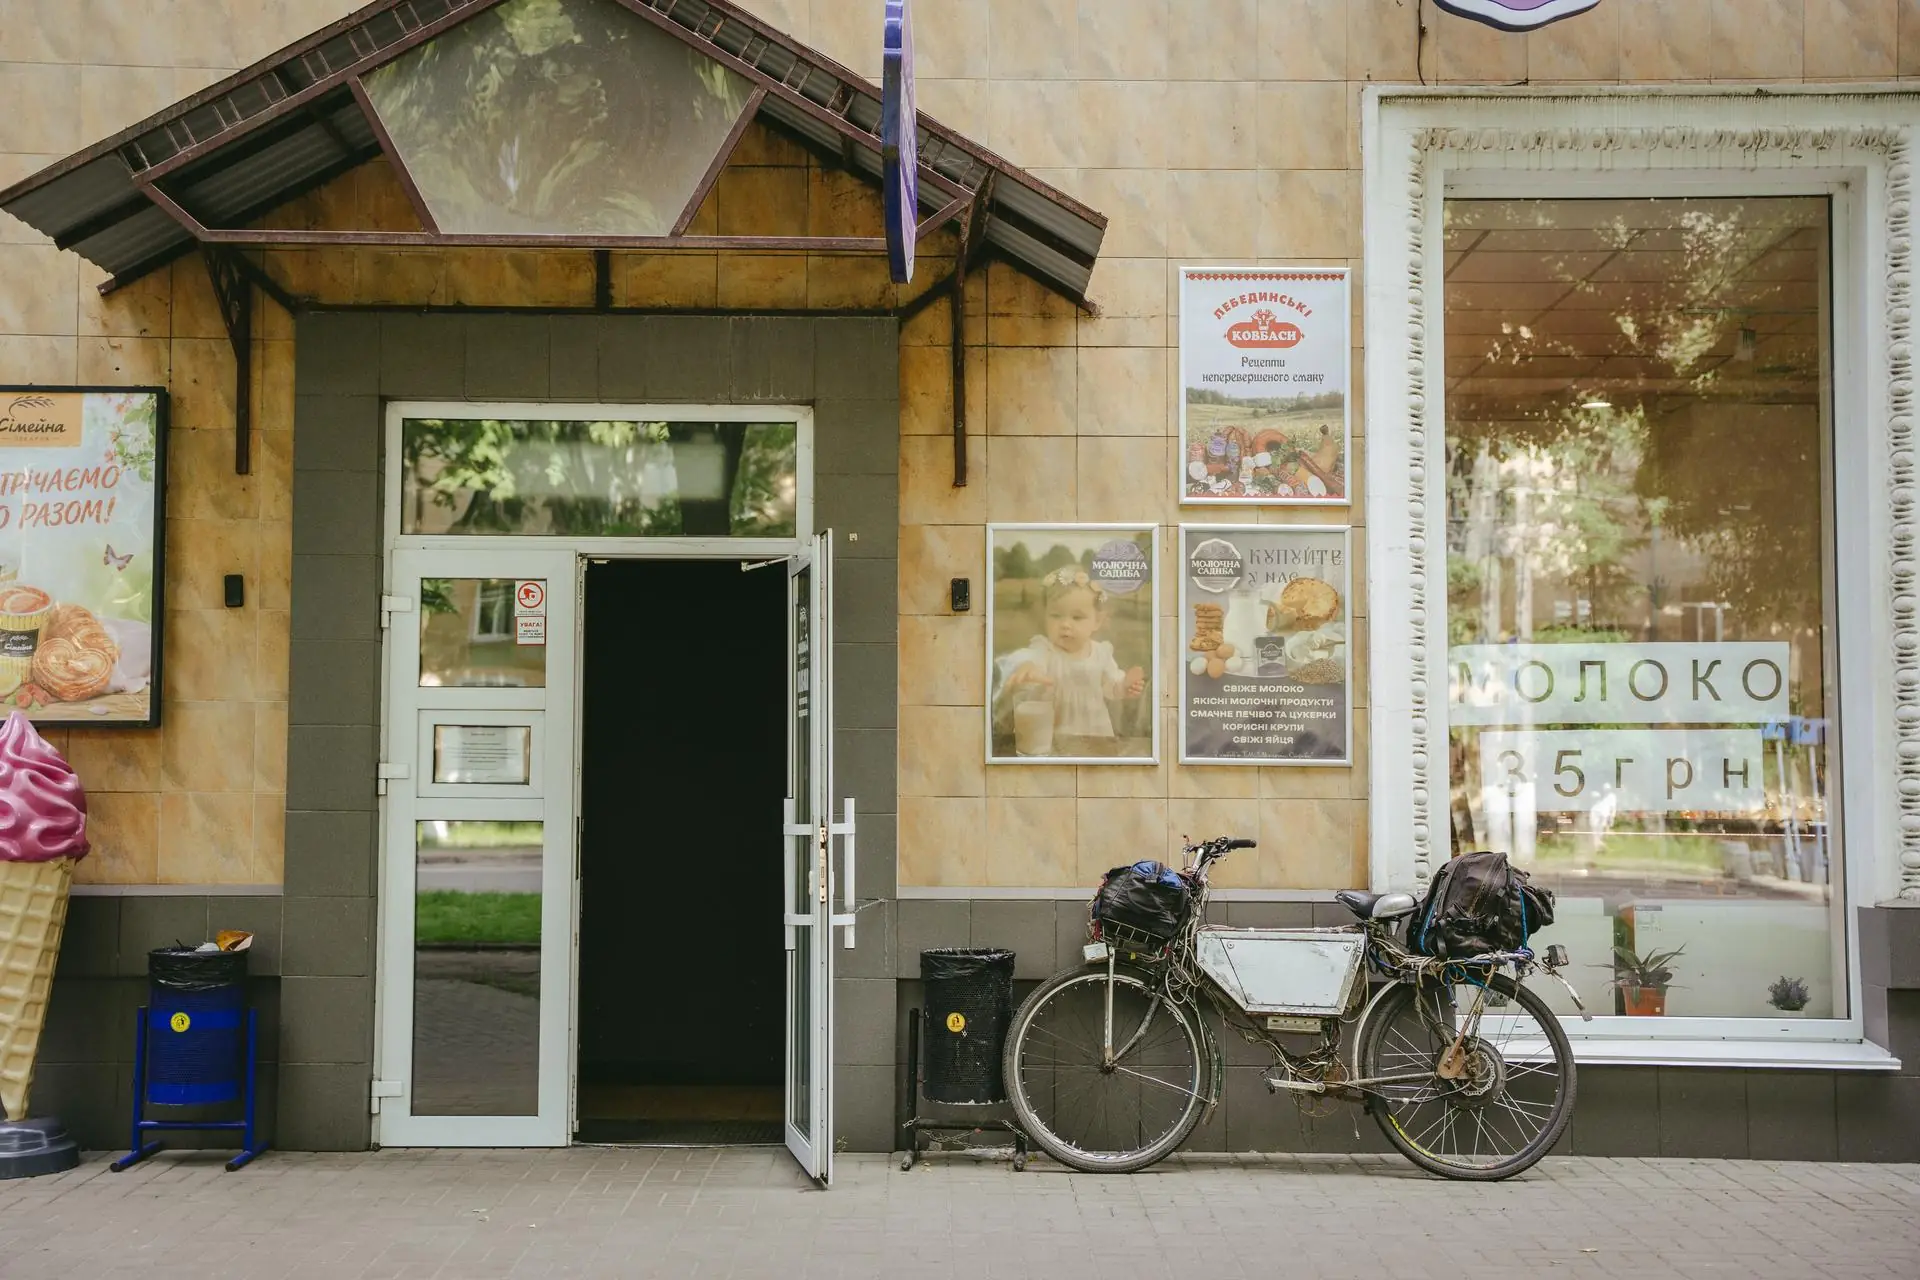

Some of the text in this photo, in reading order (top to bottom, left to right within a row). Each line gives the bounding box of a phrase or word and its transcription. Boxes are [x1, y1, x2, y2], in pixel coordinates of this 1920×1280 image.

[1213, 291, 1313, 320] ЛЕБЕДИНСЬКІ
[1232, 330, 1296, 341] КОВБАСИ
[1241, 356, 1285, 368] Рецепти
[1202, 372, 1324, 384] неперевершеного смаку
[0, 417, 67, 433] Сімейна
[19, 496, 116, 529] РАЗОМ!
[1249, 546, 1342, 565] КУПУЙТЕ
[1092, 561, 1148, 569] МОЛОЧНА
[1192, 560, 1240, 568] МОЛОЧНА
[1099, 570, 1140, 578] САДИБА
[1248, 572, 1257, 587] У
[1458, 658, 1783, 705] МОЛОКО
[1223, 685, 1304, 693] СВІЖЕ МОЛОКО
[1280, 698, 1334, 707] ПРОДУКТИ
[1190, 710, 1233, 718] СМАЧНЕ
[1289, 711, 1336, 720] ЦУКЕРКИ
[1223, 723, 1268, 731] КОРИСНІ
[1265, 735, 1294, 745] ЯЙЦЯ
